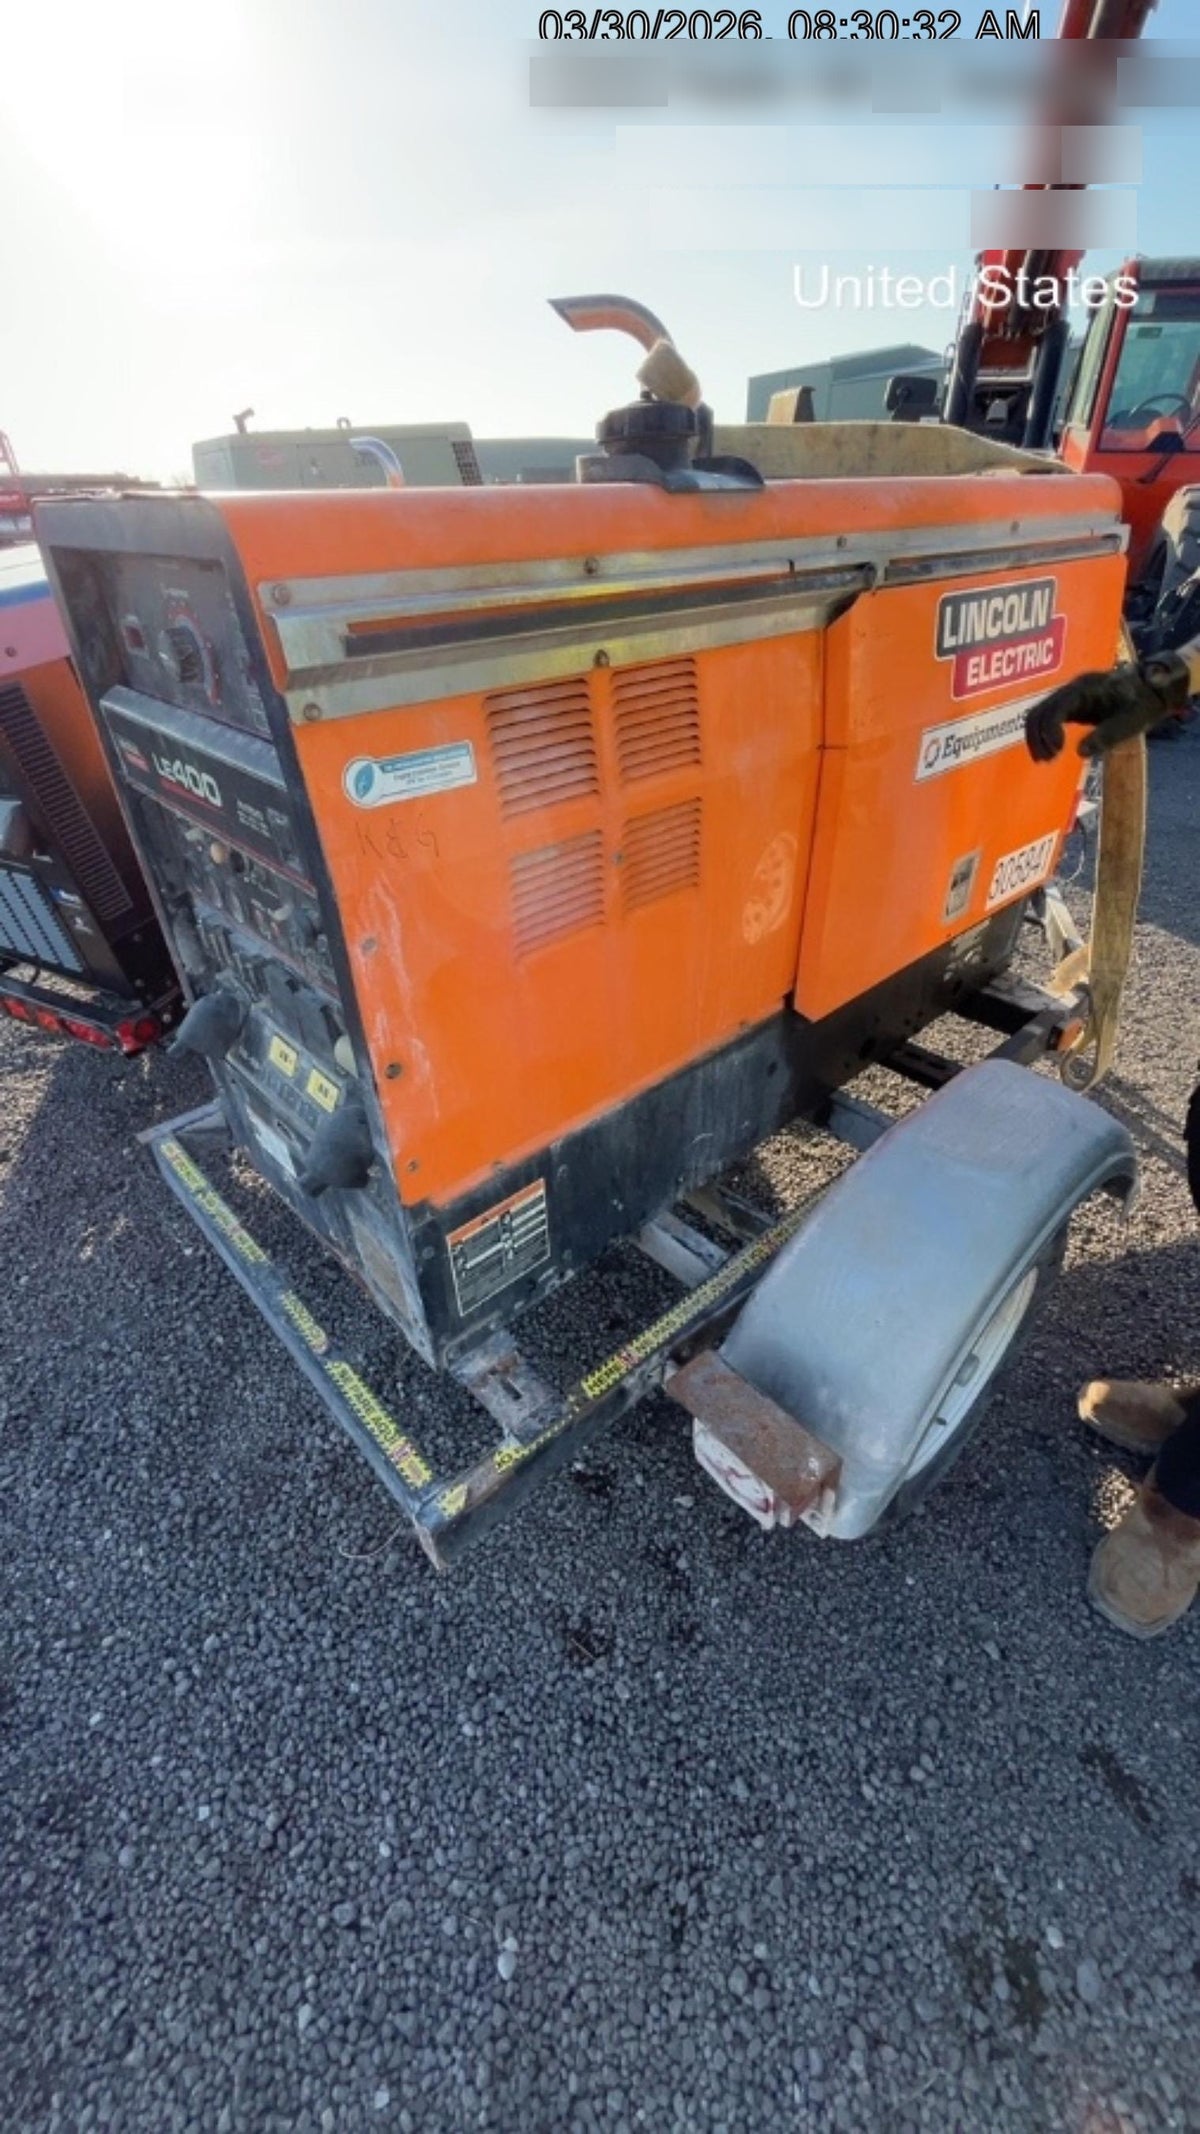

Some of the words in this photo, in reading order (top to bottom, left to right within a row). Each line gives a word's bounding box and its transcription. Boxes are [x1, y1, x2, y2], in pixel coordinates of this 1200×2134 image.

[943, 588, 1050, 648] LINCOLN
[966, 637, 1054, 686] ELECTRIC
[152, 752, 222, 807] LE400
